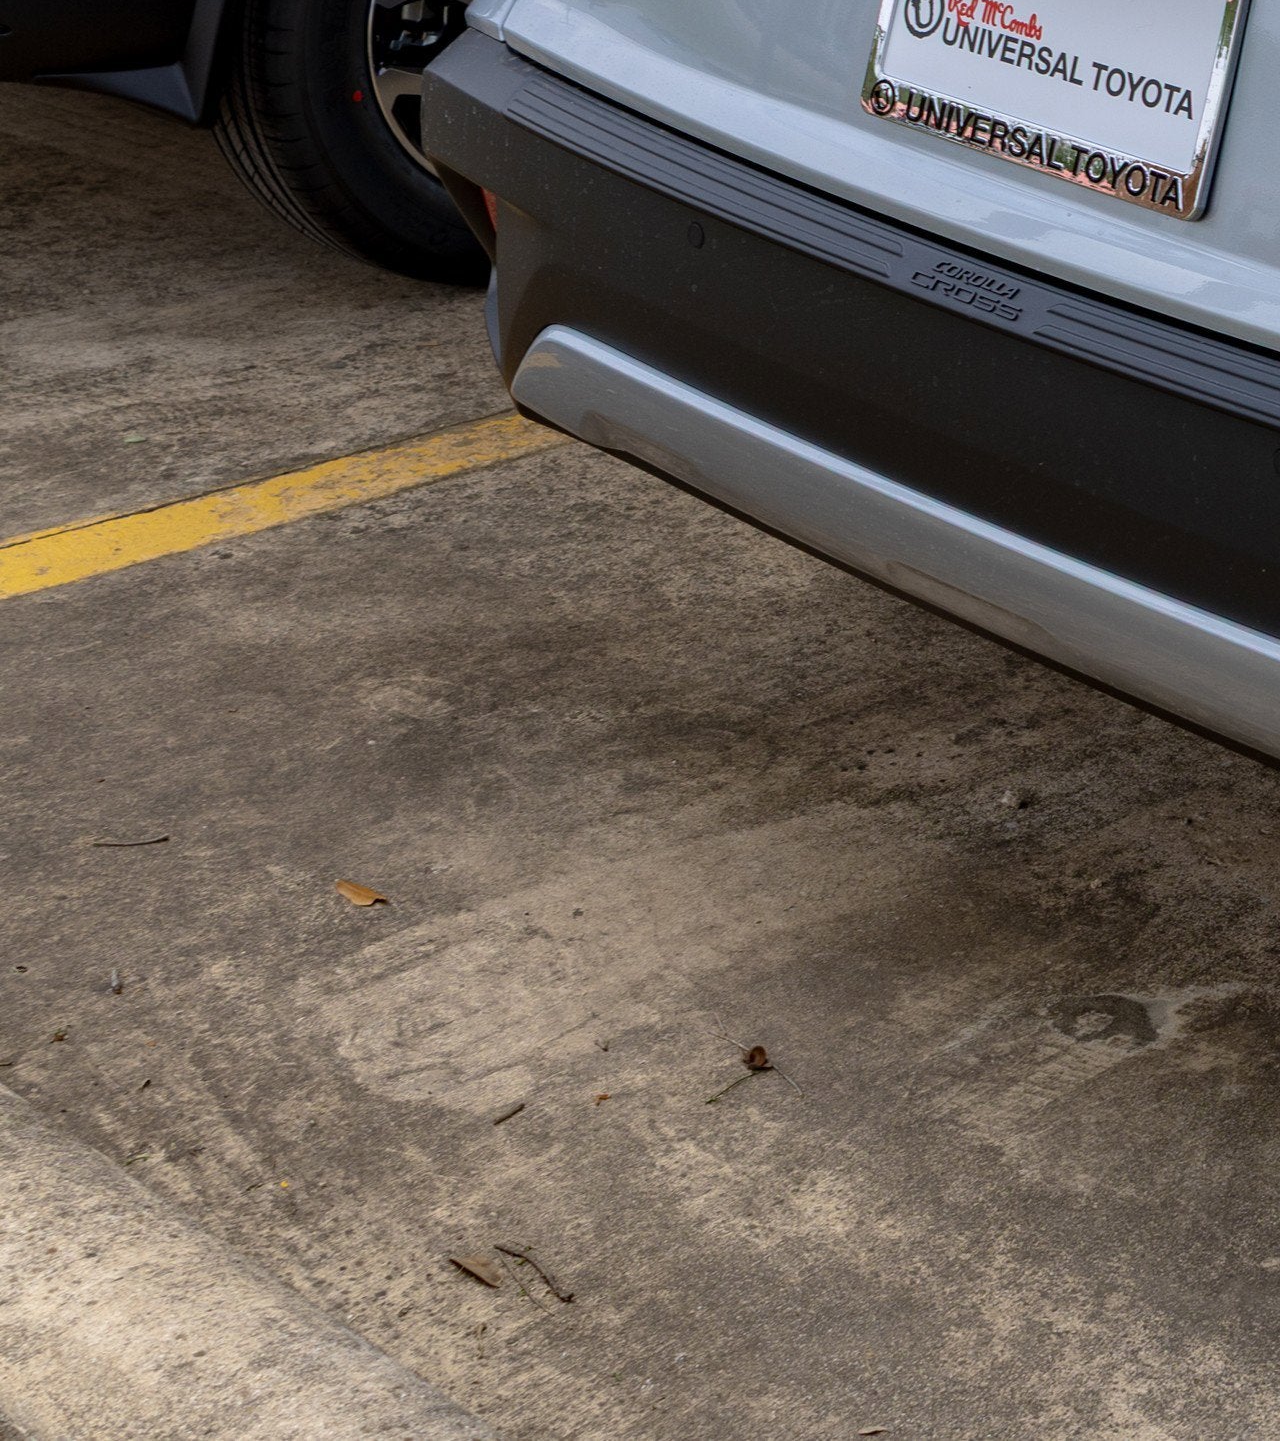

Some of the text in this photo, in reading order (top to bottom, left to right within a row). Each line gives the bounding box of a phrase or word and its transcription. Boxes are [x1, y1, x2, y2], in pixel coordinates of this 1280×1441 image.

[942, 17, 1194, 120] UNIVERSAL TOYOTA
[904, 89, 1185, 213] UNIVERSAL TOYOTA
[911, 271, 1024, 322] CROSS
[932, 261, 1021, 300] COROLLA
